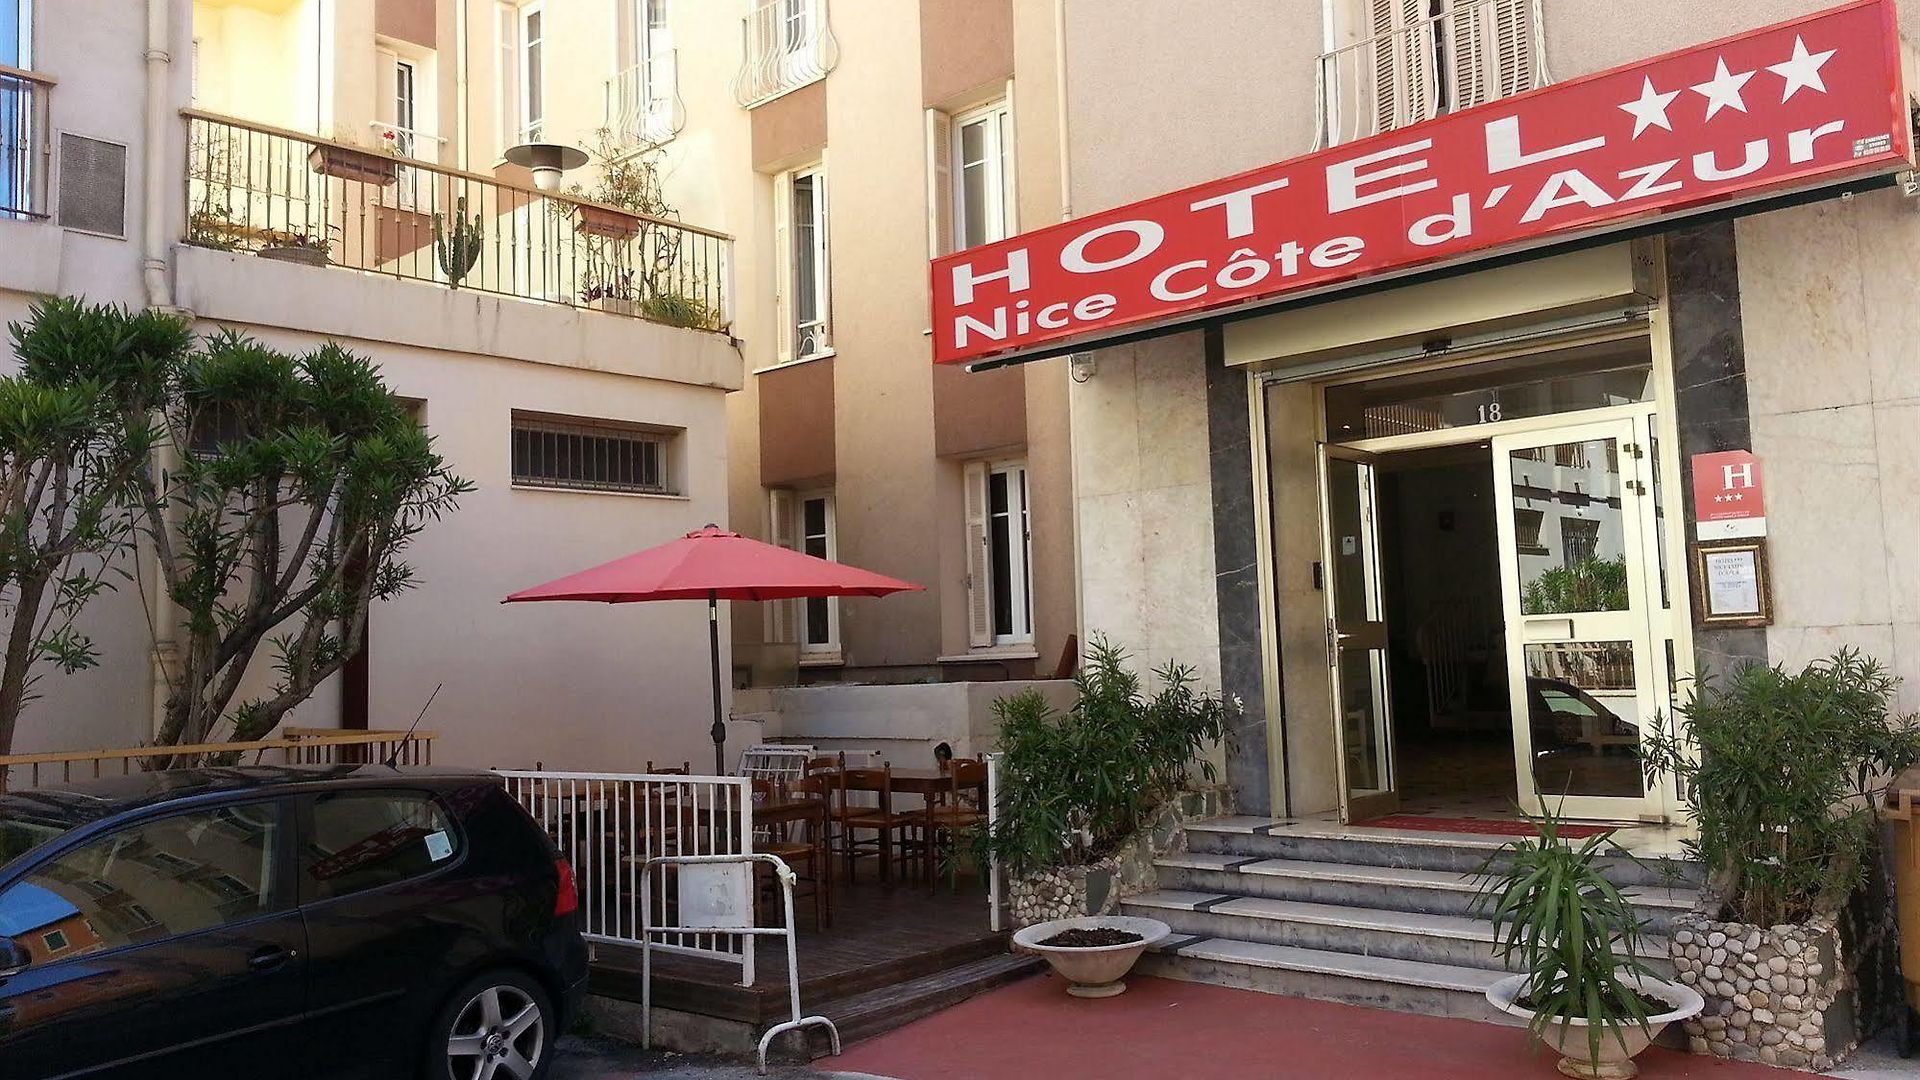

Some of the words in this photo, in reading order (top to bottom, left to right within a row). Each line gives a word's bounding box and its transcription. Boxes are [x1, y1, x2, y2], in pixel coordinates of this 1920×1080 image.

[952, 115, 1606, 306] HOTEL
[955, 294, 1117, 349] Nice
[1149, 236, 1365, 302] Côte
[1408, 119, 1845, 246] d'Azur
[1478, 403, 1501, 423] 18
[1722, 463, 1755, 490] H
